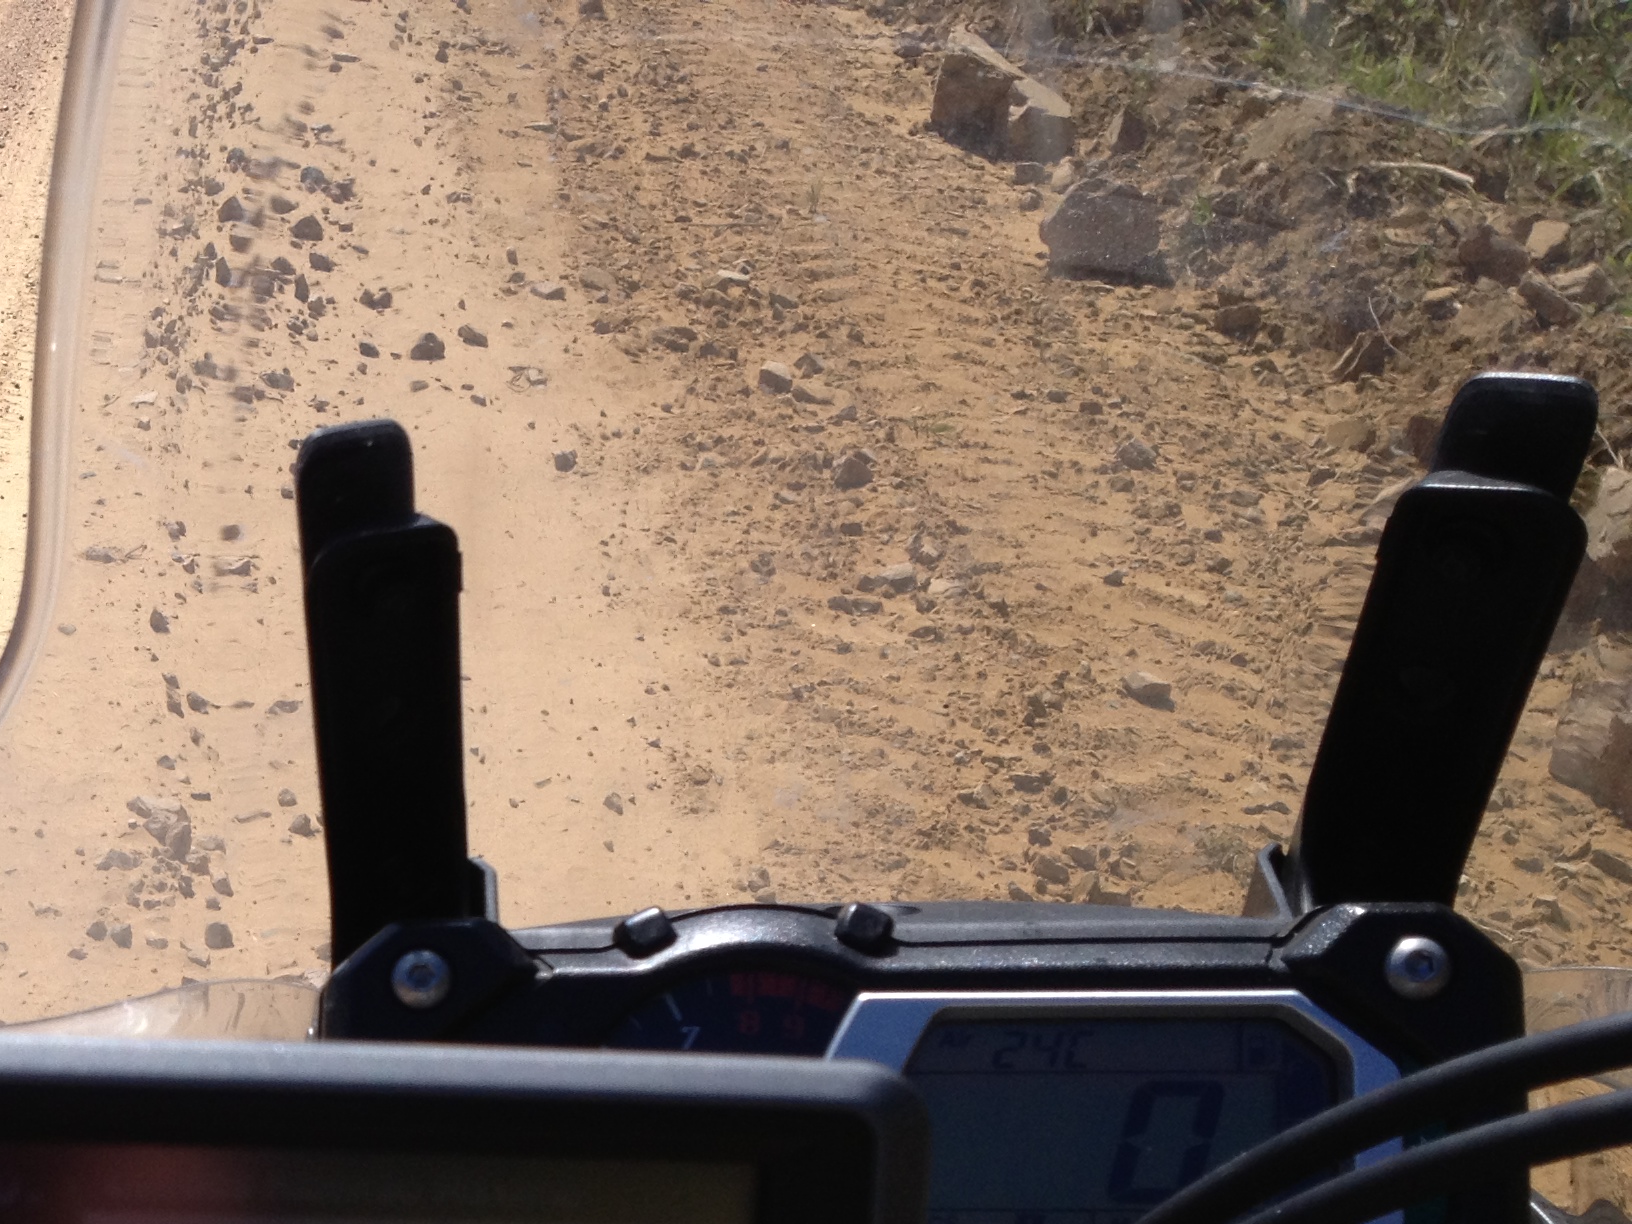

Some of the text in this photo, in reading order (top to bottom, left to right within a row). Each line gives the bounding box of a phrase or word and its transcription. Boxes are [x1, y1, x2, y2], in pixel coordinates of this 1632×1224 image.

[680, 1025, 701, 1050] 7
[739, 1011, 760, 1034] 8
[1107, 1080, 1225, 1204] 0
